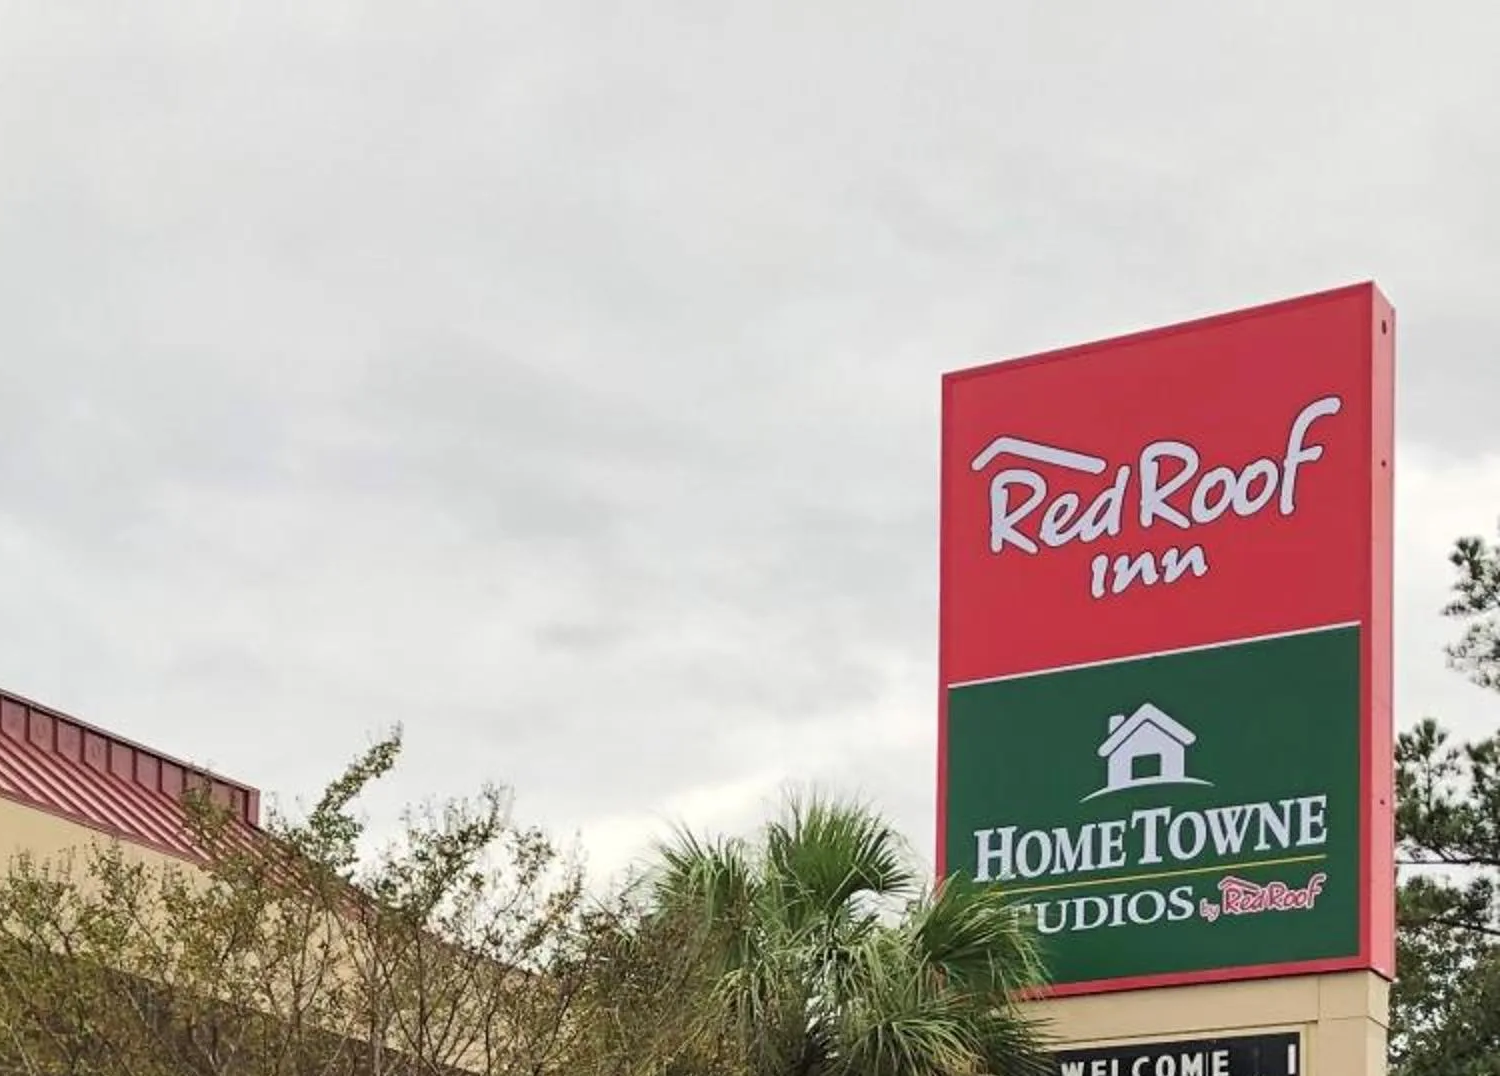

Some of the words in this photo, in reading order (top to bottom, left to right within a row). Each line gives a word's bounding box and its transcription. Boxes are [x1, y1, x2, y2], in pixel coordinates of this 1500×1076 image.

[989, 465, 1132, 553] Red
[1139, 395, 1341, 528] Roof
[1200, 898, 1219, 921] by
[1268, 874, 1327, 907] Roof
